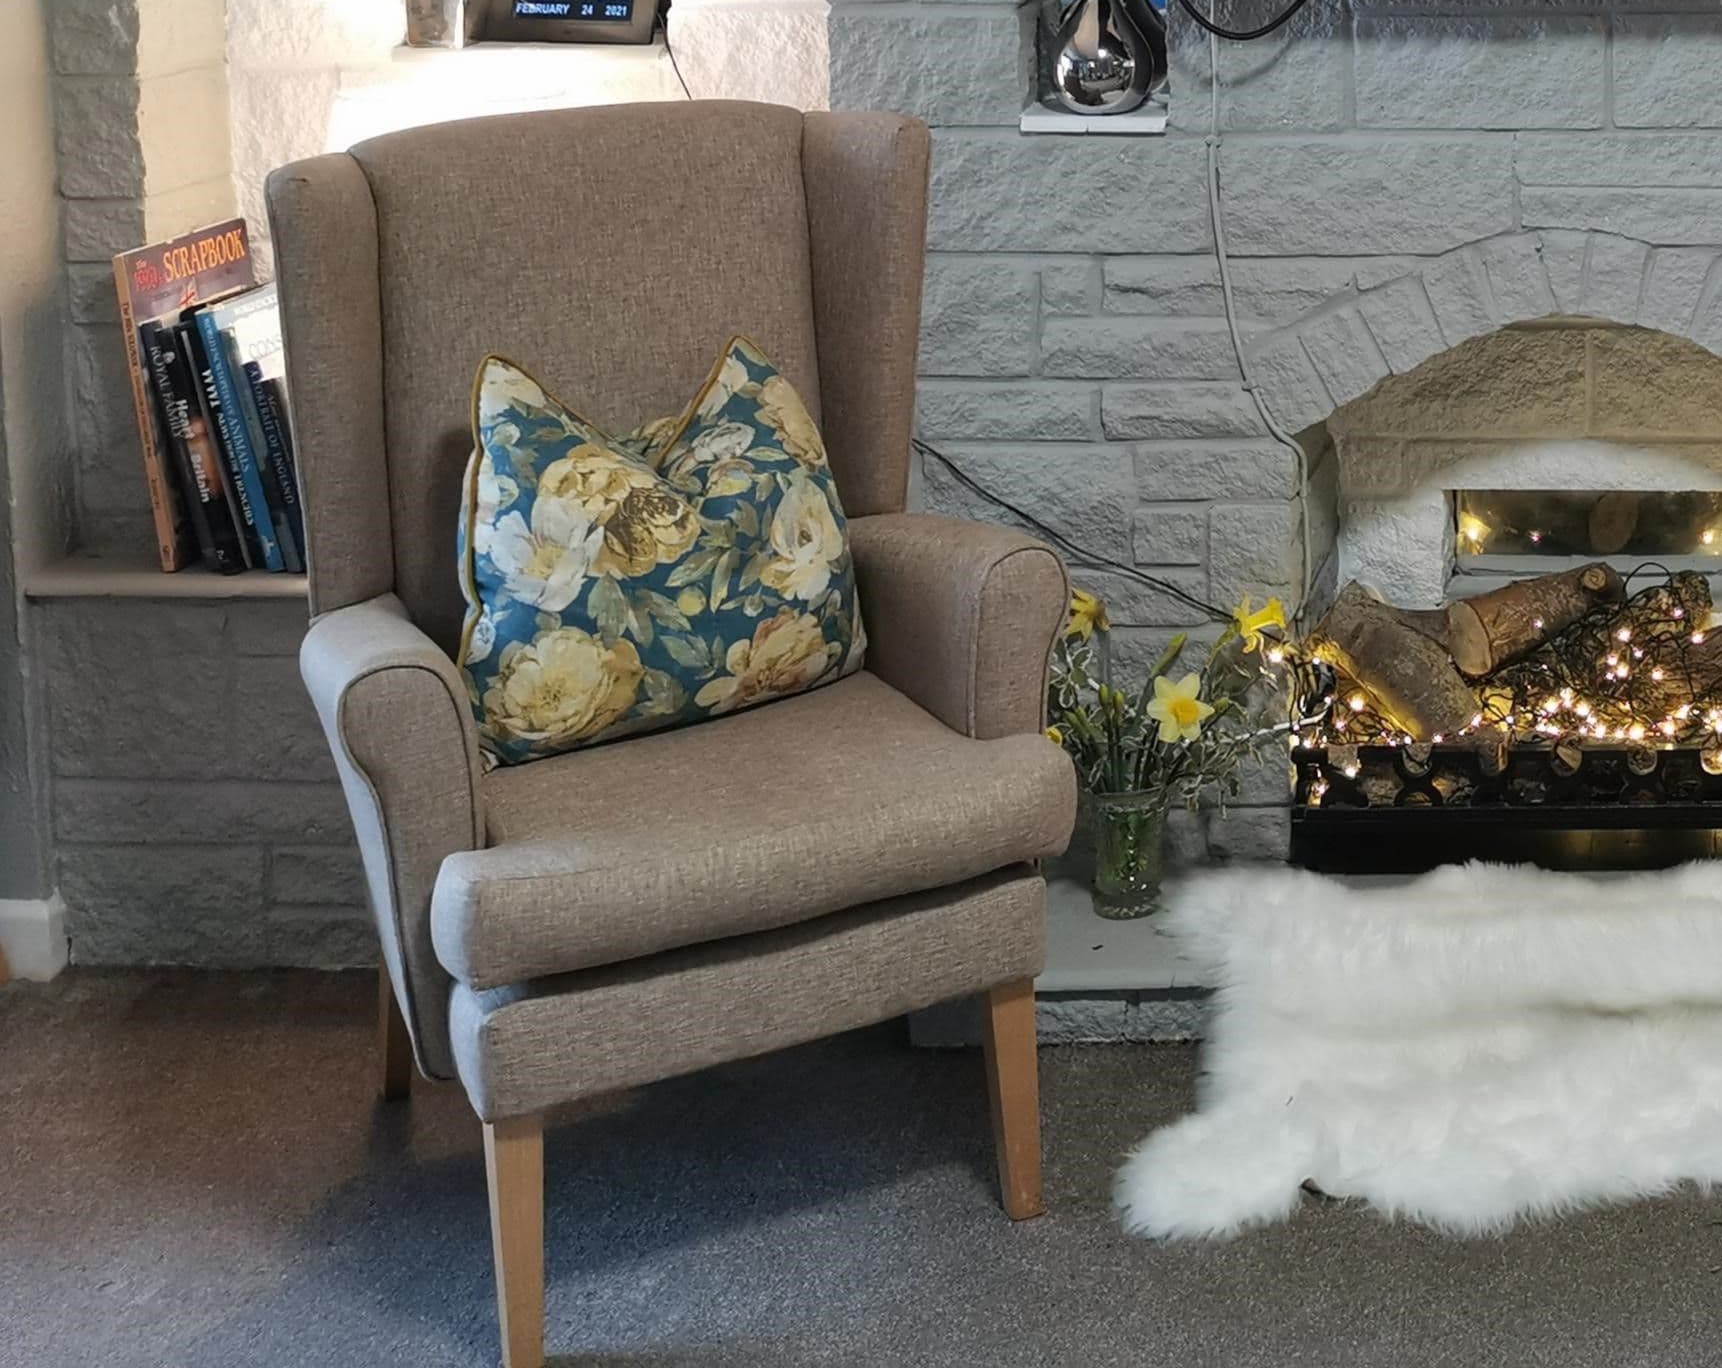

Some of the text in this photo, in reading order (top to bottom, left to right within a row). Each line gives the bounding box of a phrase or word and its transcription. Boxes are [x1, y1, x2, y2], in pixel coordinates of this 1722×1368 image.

[516, 2, 627, 17] FEBRUARY 24 2021
[163, 228, 246, 283] SCRAPBOOK
[149, 345, 184, 440] ROYAL FAMILY
[252, 380, 275, 432] PORTRAIT
[175, 399, 212, 503] Heart Britain
[229, 415, 252, 473] ANIMALS
[267, 433, 280, 448] OF
[272, 452, 295, 505] ENGLAND
